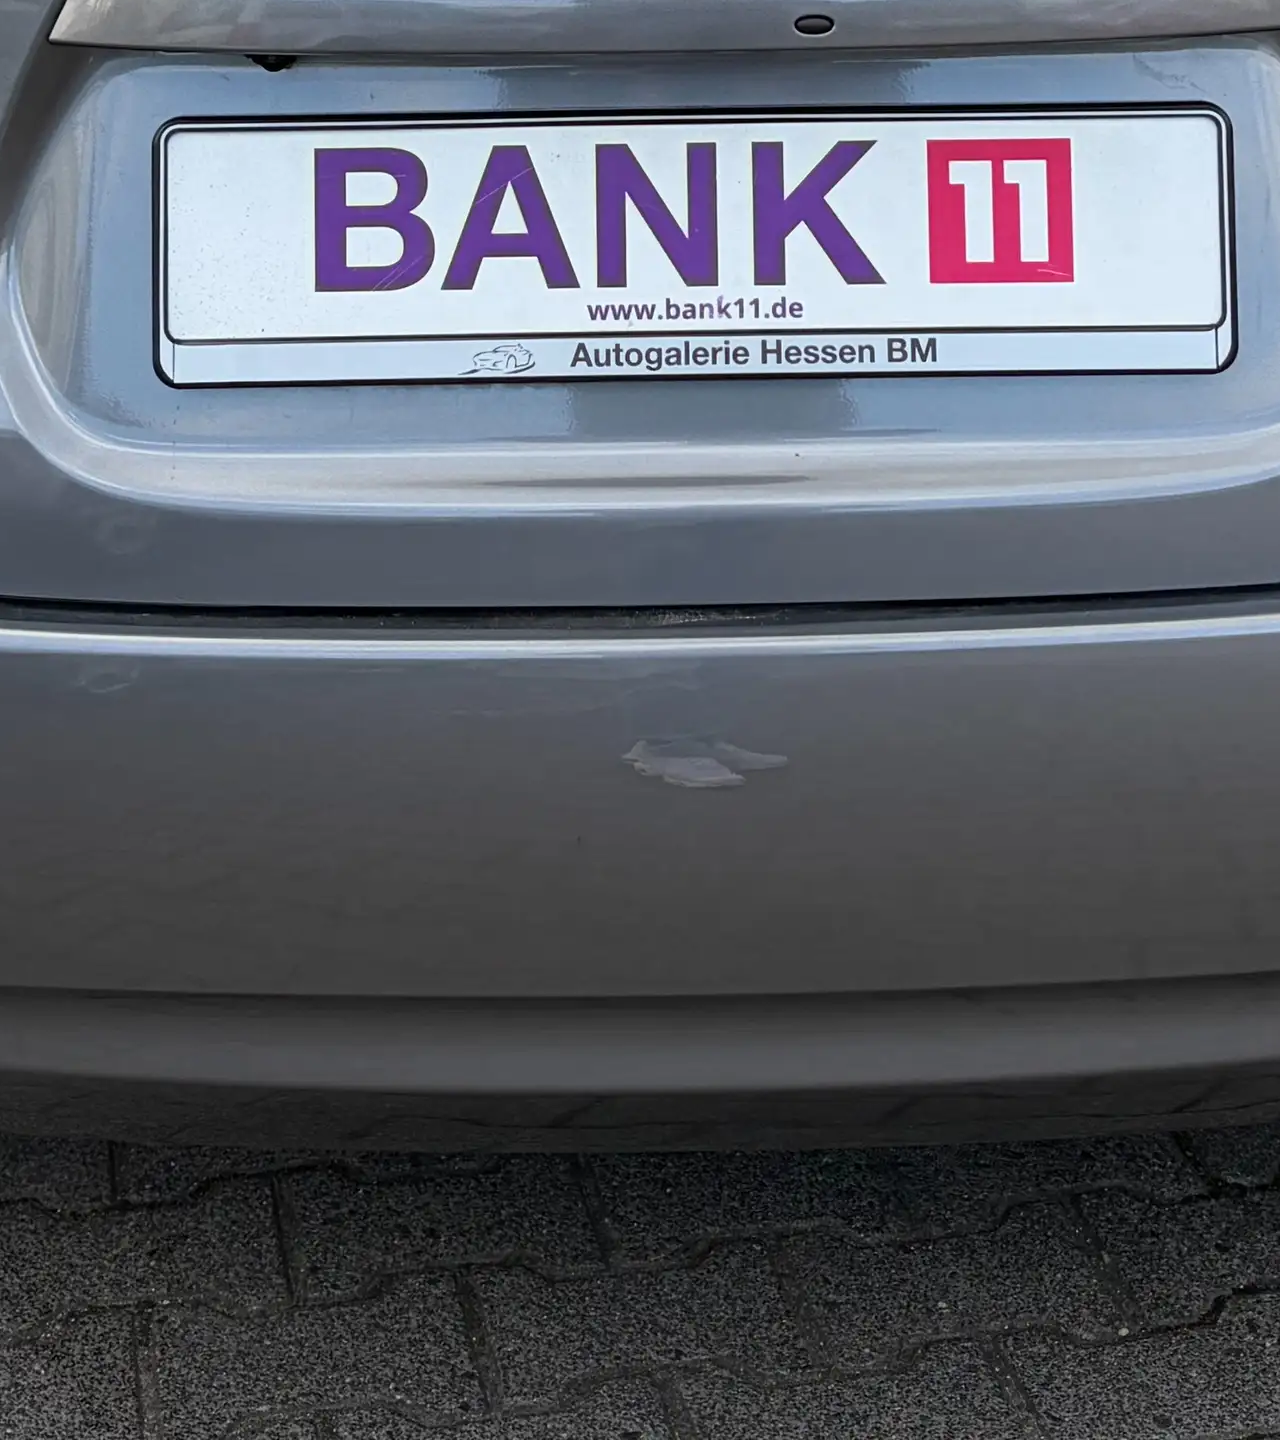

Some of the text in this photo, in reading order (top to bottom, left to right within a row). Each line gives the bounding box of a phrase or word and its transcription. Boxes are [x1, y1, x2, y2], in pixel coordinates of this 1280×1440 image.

[312, 139, 1051, 293] BANK 11
[586, 295, 804, 321] www.bank11.de
[569, 337, 938, 371] Autogalerie Hessen BM
